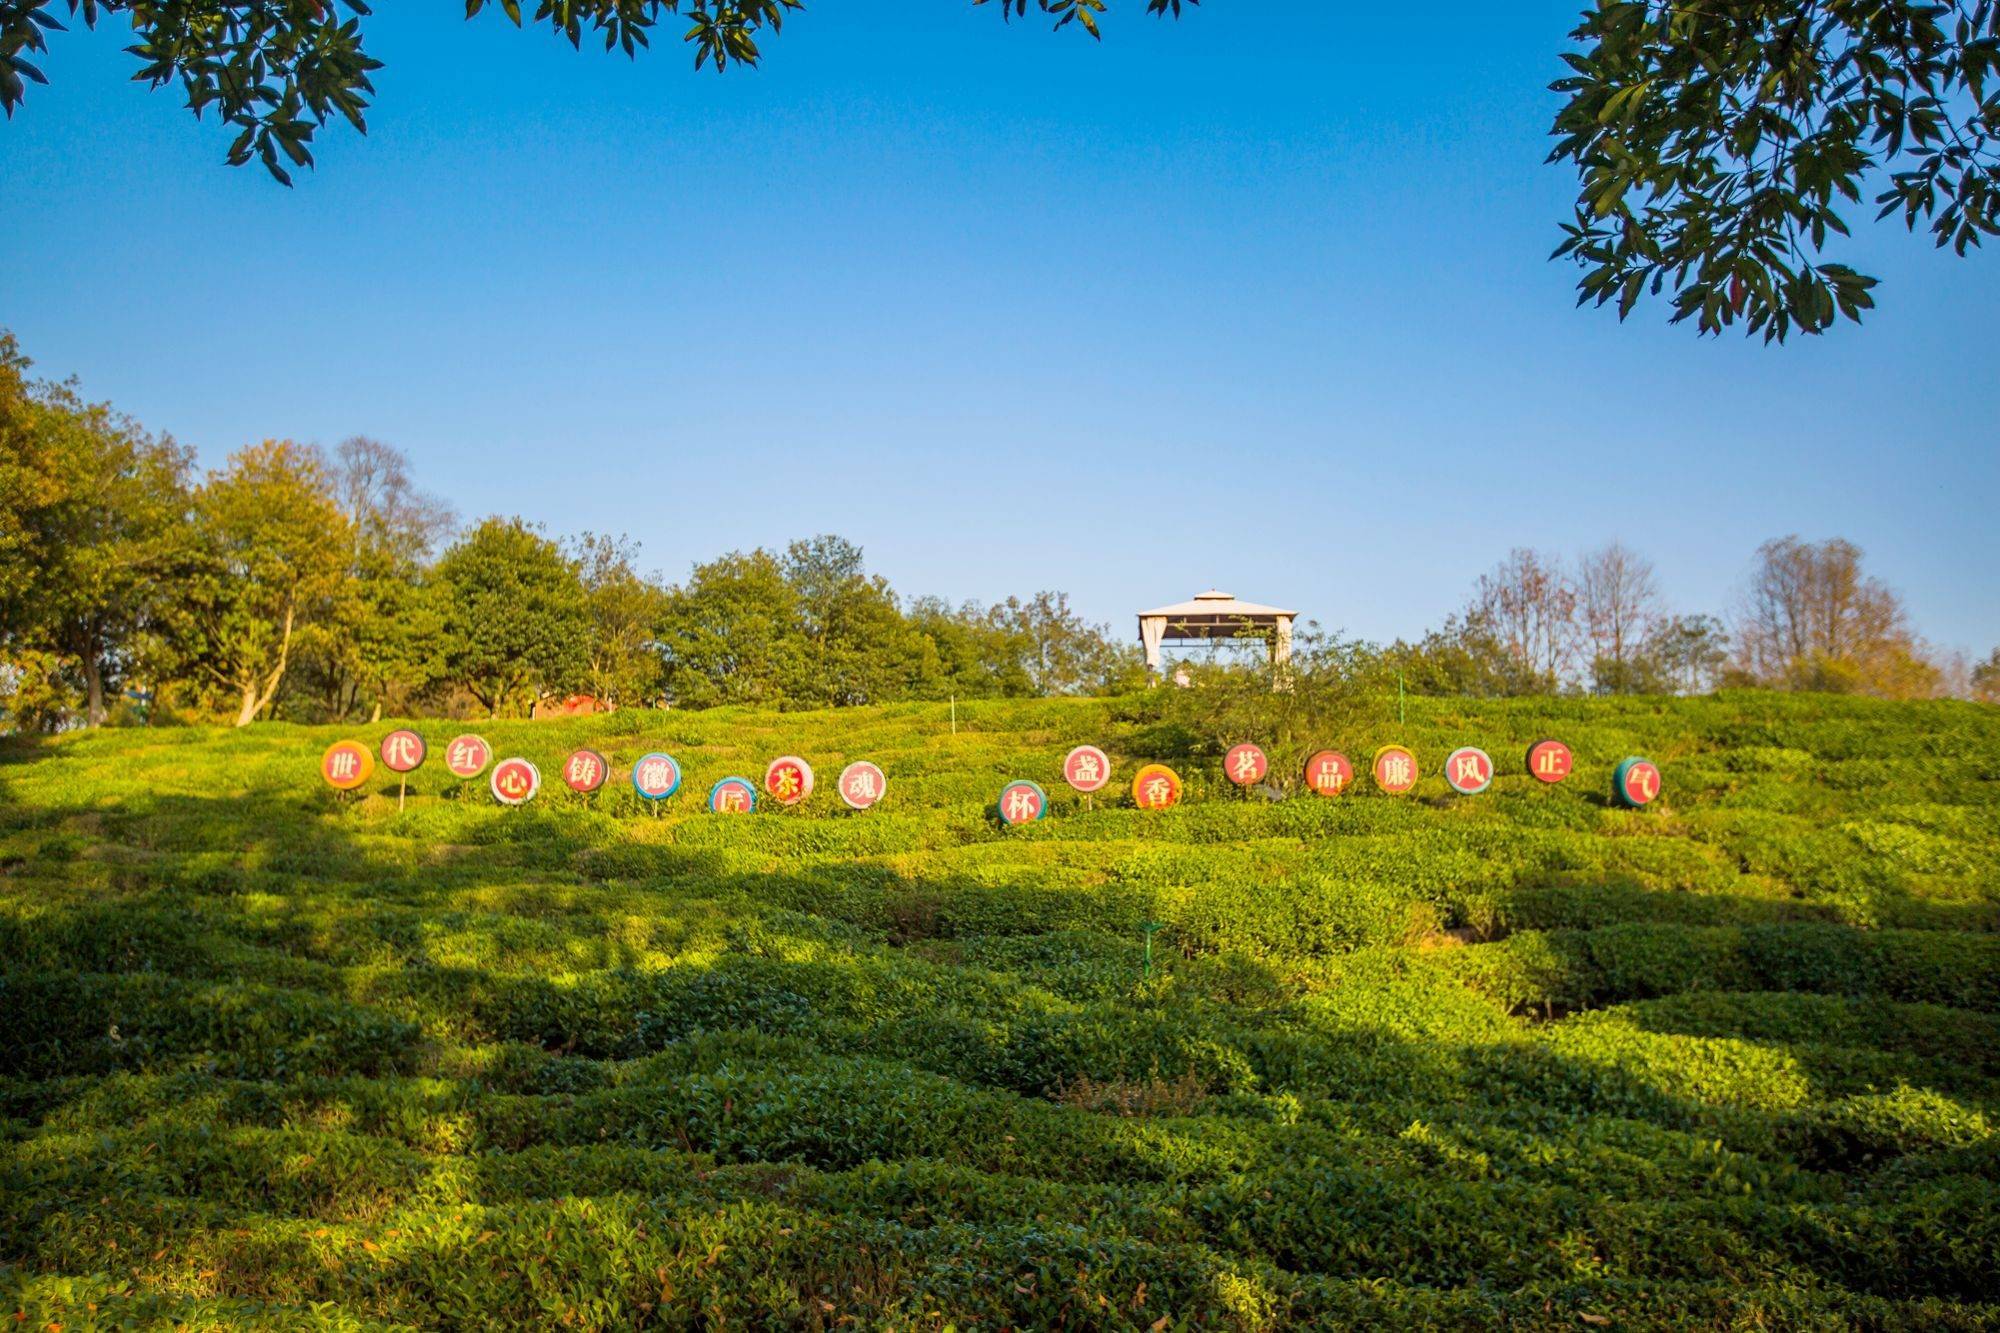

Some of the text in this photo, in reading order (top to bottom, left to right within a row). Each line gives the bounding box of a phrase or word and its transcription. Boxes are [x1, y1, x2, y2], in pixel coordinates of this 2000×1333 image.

[388, 736, 416, 766] 代
[452, 742, 479, 769] 红
[1233, 750, 1261, 779] 茗
[1536, 748, 1565, 775] 正
[332, 752, 357, 779] 世
[568, 756, 596, 786] 铸
[643, 762, 670, 791] 徽
[1072, 754, 1100, 782] 盏
[1316, 761, 1343, 789] 品
[1383, 758, 1411, 785] 廉
[1455, 757, 1486, 783] 风
[501, 770, 528, 794] 心
[774, 767, 800, 795] 茶
[848, 771, 875, 799] 魂
[1146, 777, 1172, 807] 香
[1628, 768, 1654, 799] 气
[1007, 790, 1036, 820] 杯
